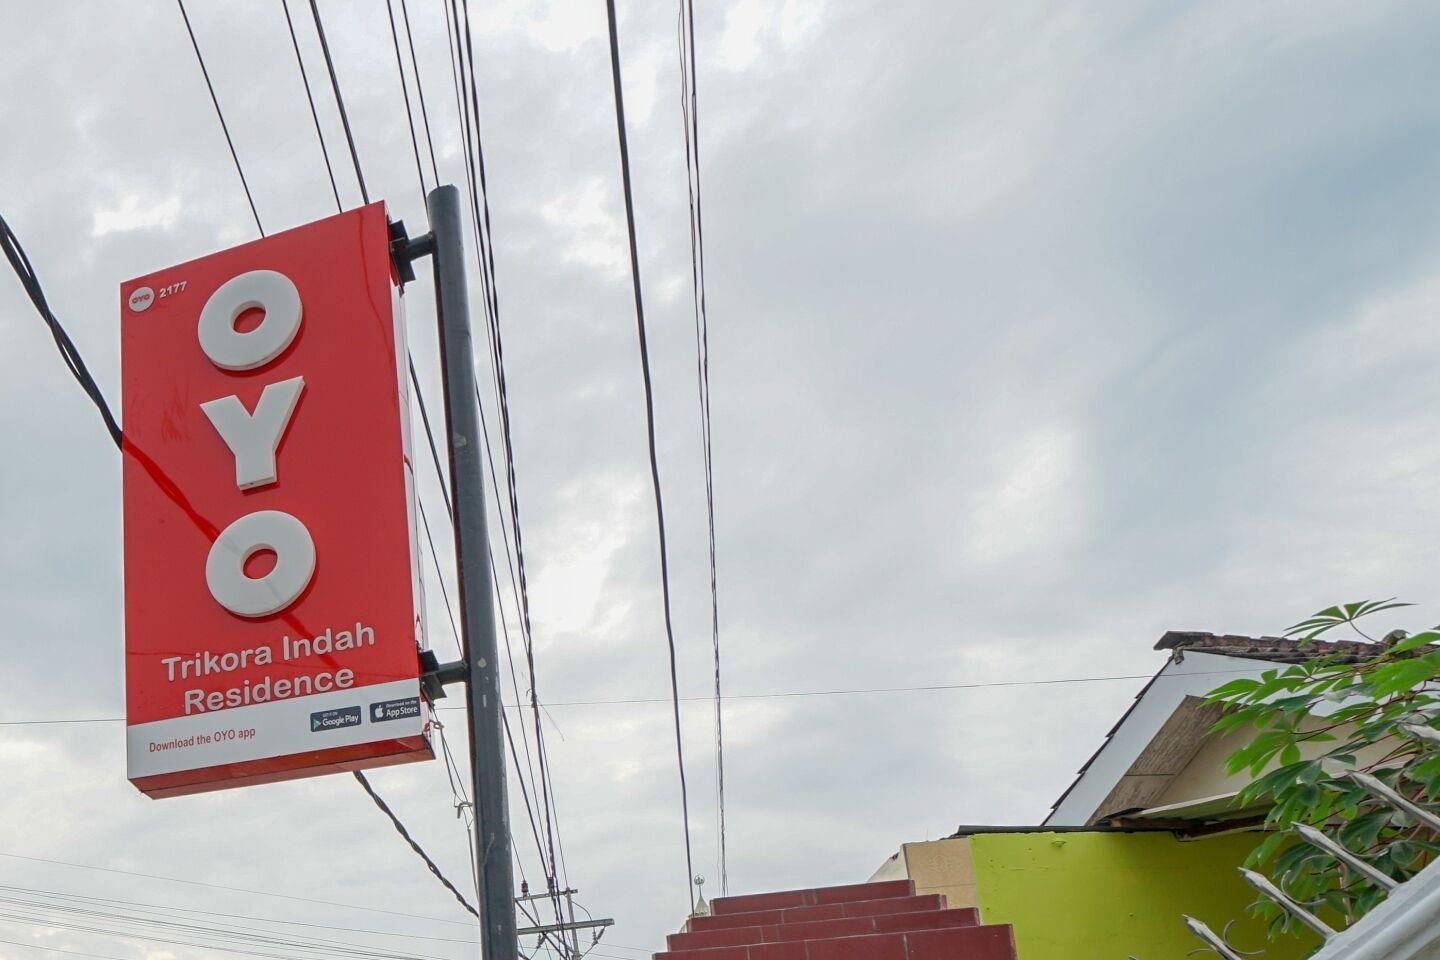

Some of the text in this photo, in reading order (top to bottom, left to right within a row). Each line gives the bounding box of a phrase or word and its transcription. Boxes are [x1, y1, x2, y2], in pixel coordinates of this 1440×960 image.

[131, 293, 151, 305] OYO
[159, 280, 188, 299] 2177
[197, 269, 317, 619] OYO
[161, 622, 375, 682] Trikora Indah
[184, 667, 355, 715] Residence
[322, 715, 359, 727] Google Play
[386, 706, 418, 718] App Store
[149, 728, 256, 753] Download the OYO app
